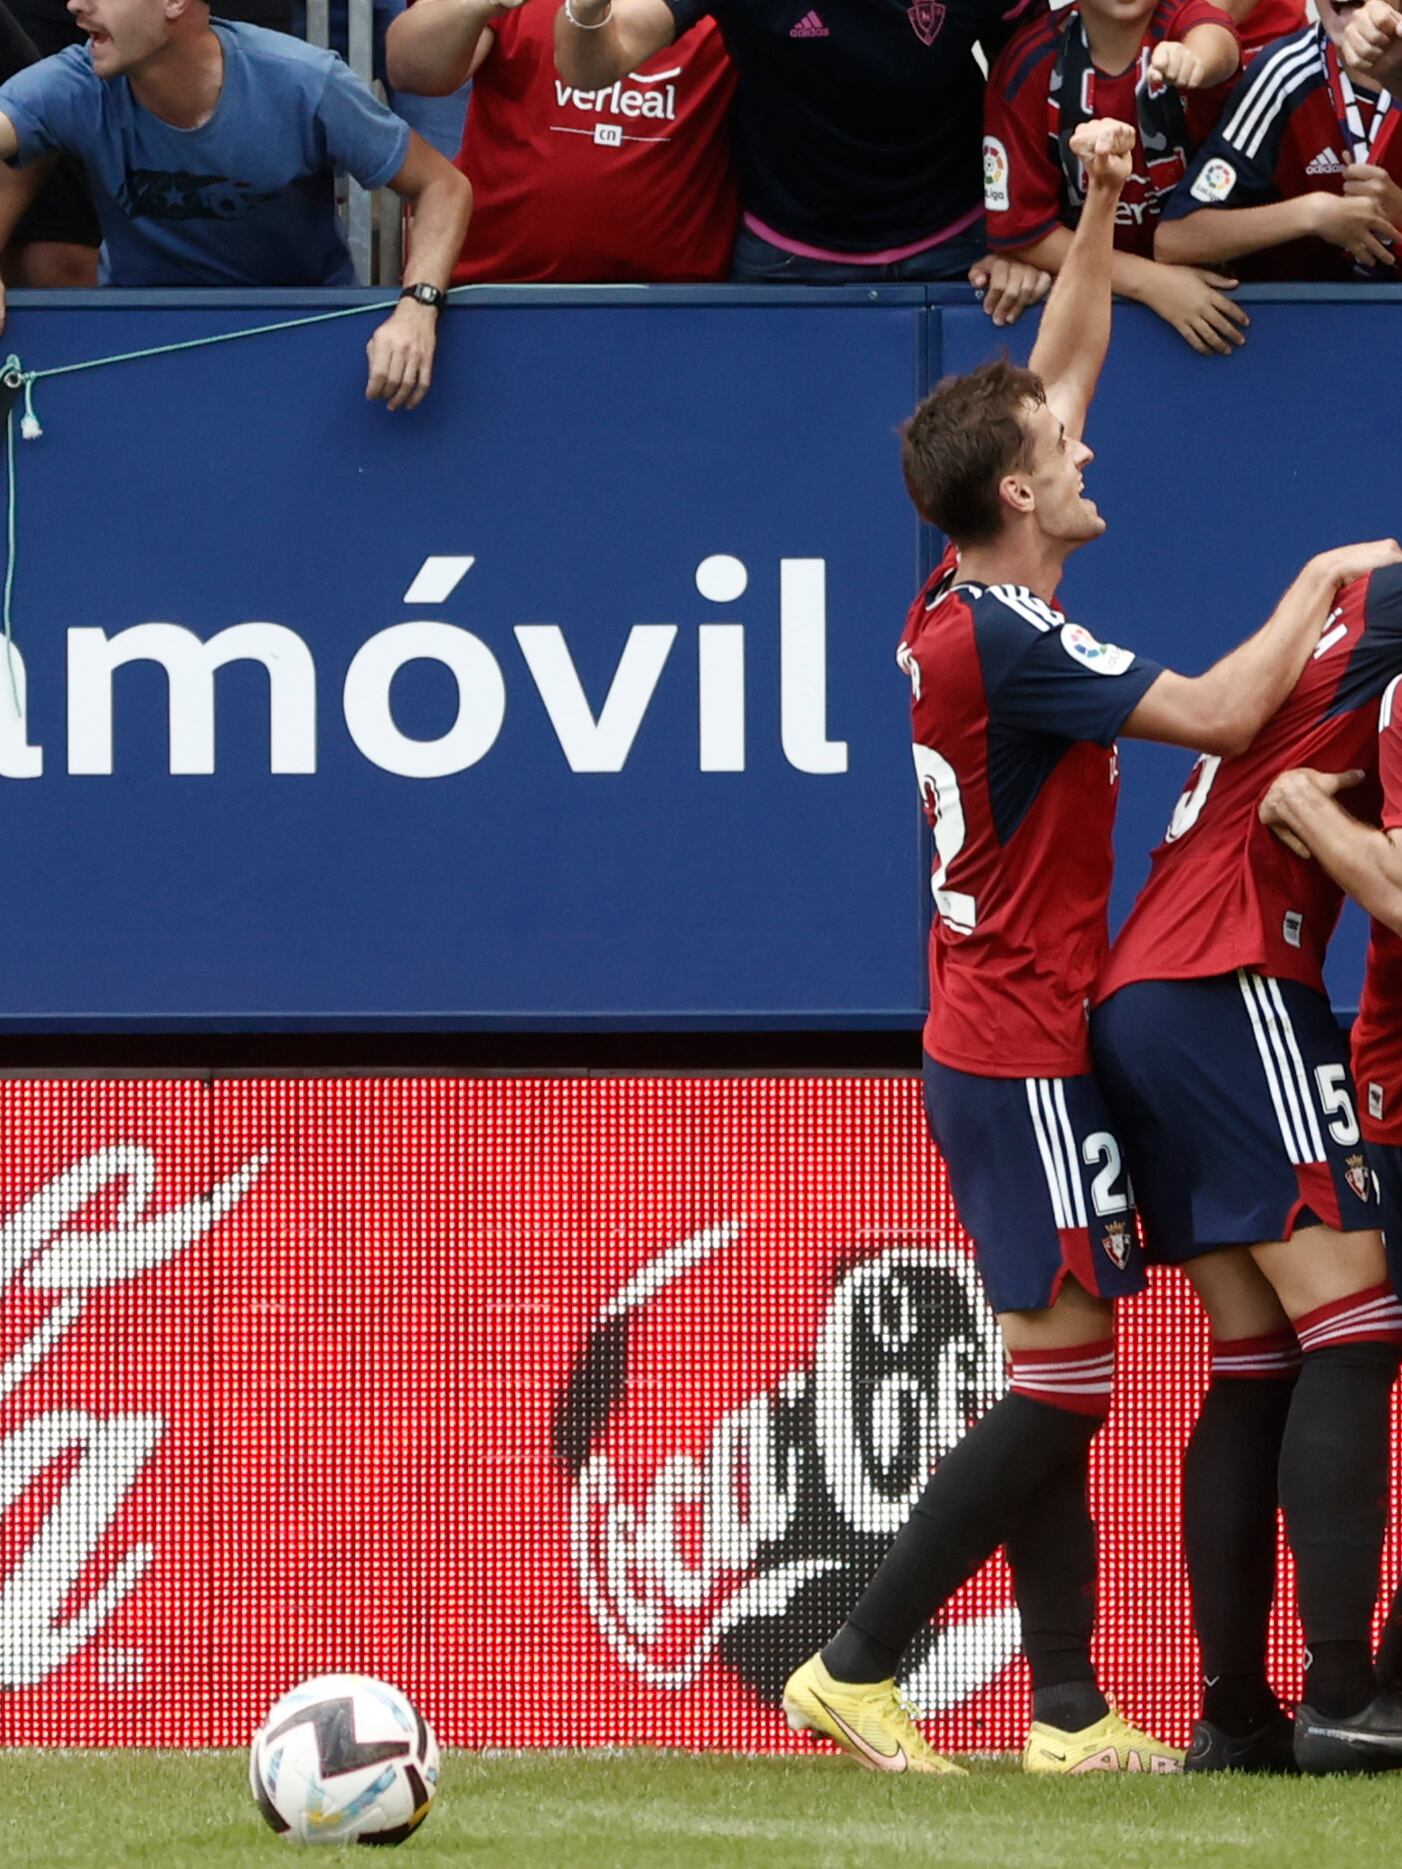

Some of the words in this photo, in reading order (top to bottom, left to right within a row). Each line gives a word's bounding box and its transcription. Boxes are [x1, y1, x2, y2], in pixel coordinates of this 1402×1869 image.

[554, 78, 676, 121] verleal
[598, 128, 617, 142] cn
[1313, 1063, 1360, 1146] 5
[1082, 1131, 1136, 1217] 2
